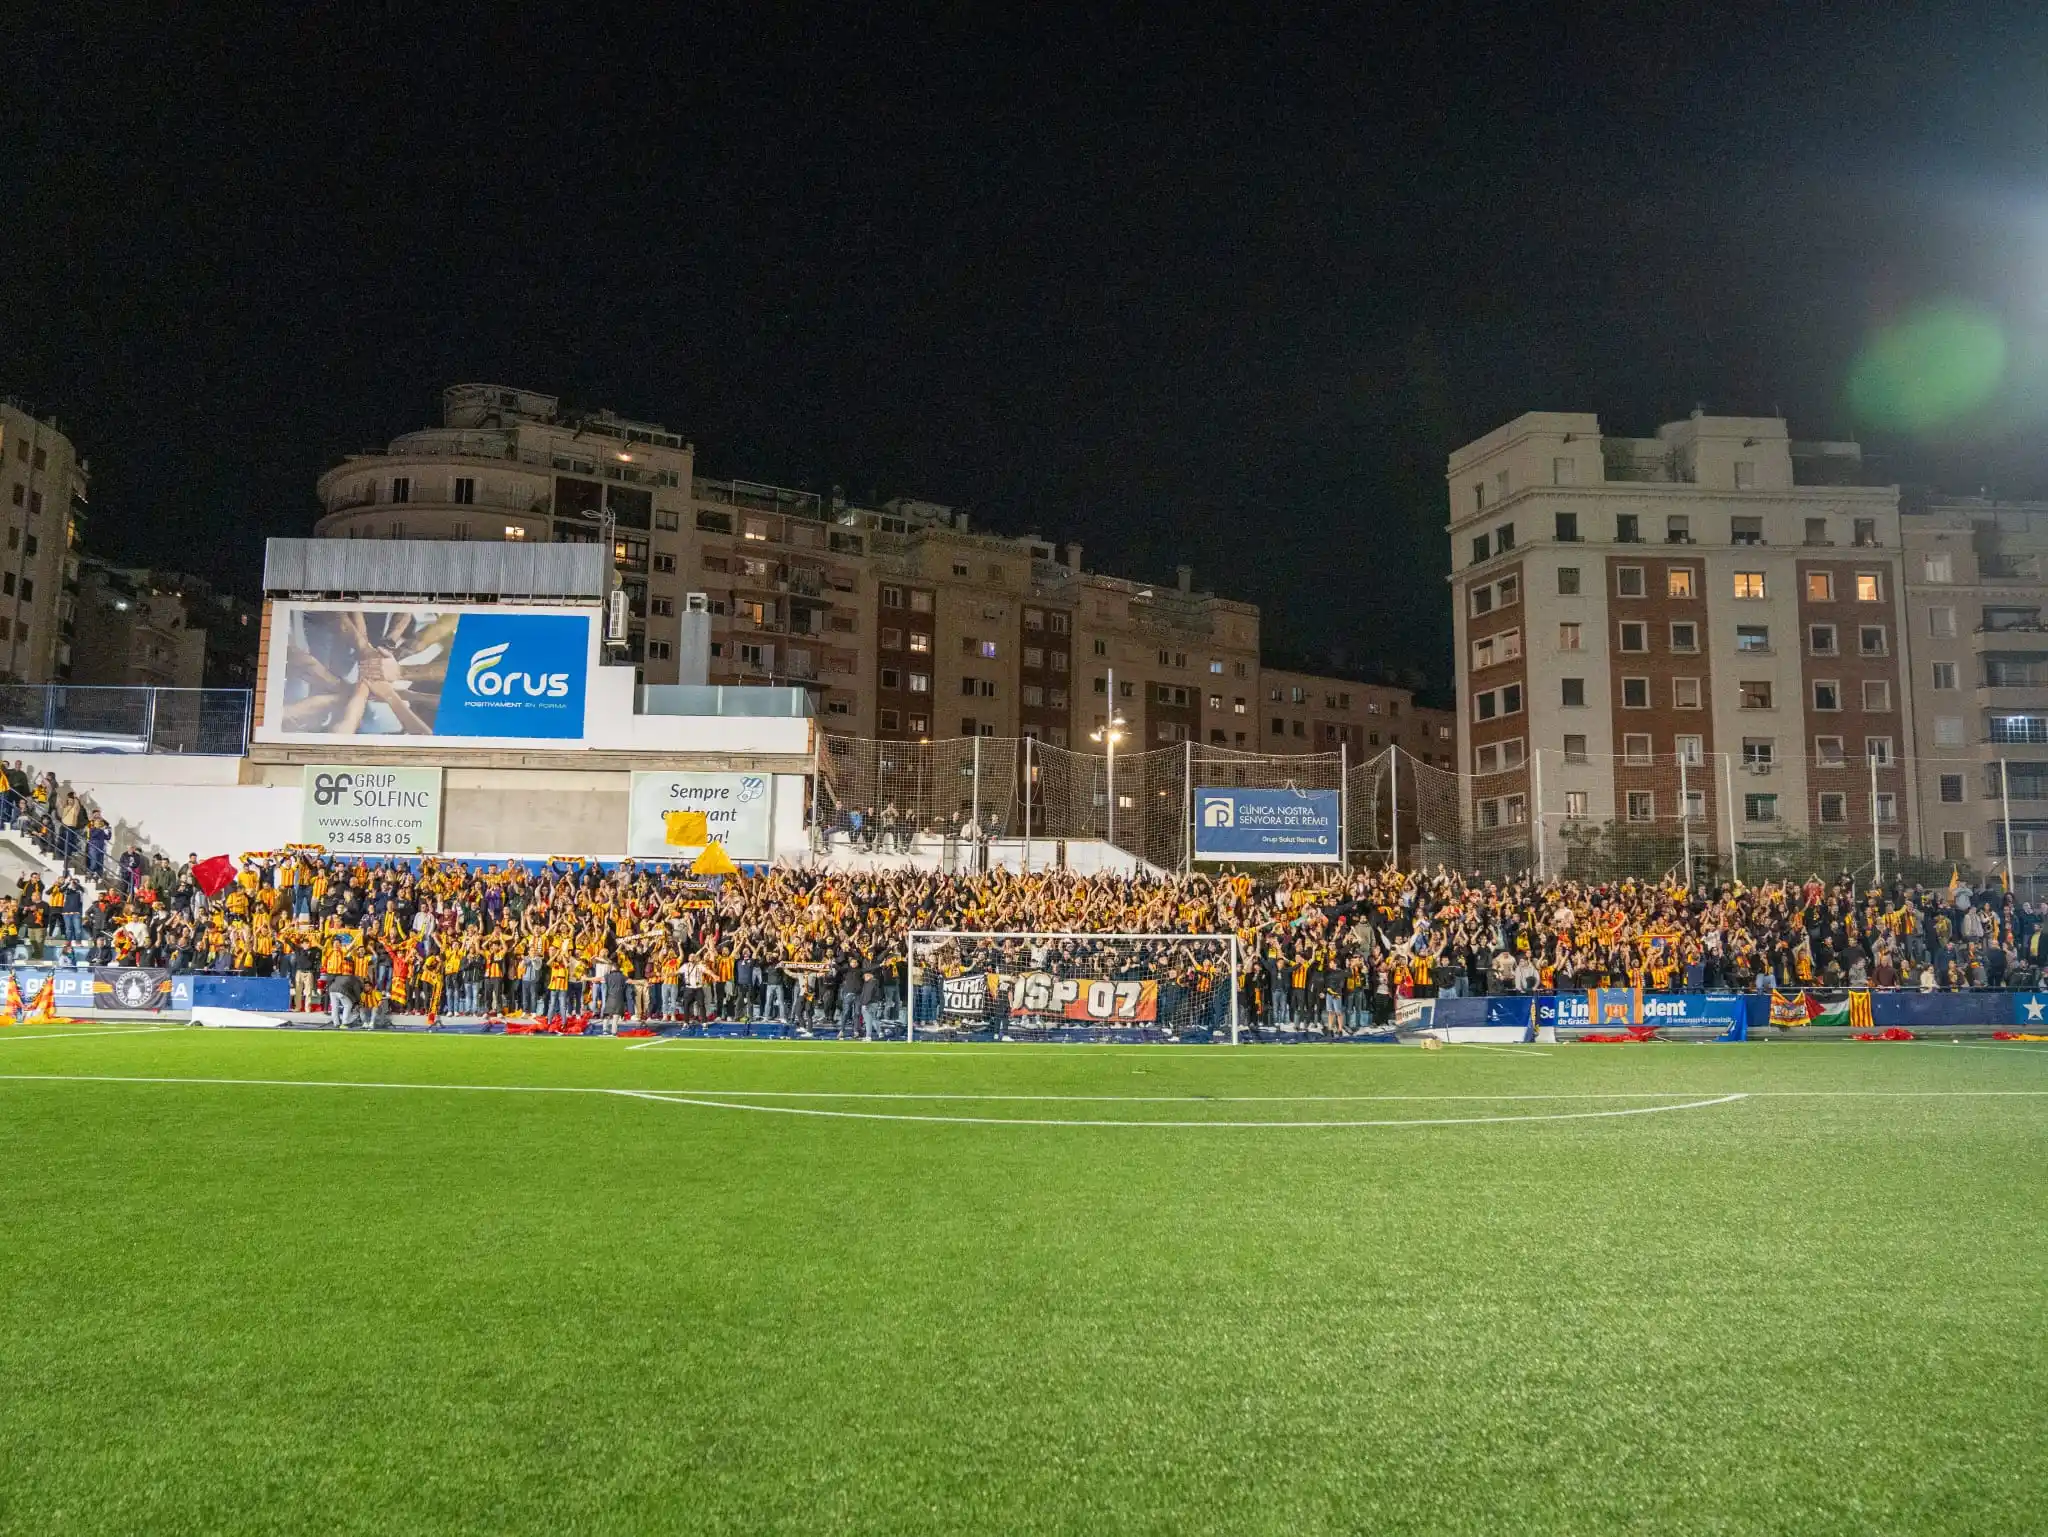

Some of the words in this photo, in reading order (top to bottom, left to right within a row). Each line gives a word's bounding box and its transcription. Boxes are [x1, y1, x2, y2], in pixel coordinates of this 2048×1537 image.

[464, 701, 523, 709] POSITIVAMENT
[354, 773, 397, 788] GRUP
[352, 790, 430, 808] SOLFINC
[669, 783, 730, 802] Sempre
[1277, 805, 1316, 816] NOSTRA
[318, 816, 423, 829] www.solfinc.com
[1239, 815, 1282, 825] SENYORA
[1284, 816, 1300, 825] DEL
[1302, 816, 1329, 826] REMEI
[328, 832, 344, 844] 93
[347, 832, 372, 844] 458
[375, 833, 392, 844] 83
[394, 833, 411, 845] 05
[25, 978, 77, 995] GUP
[1086, 980, 1143, 1019] 07
